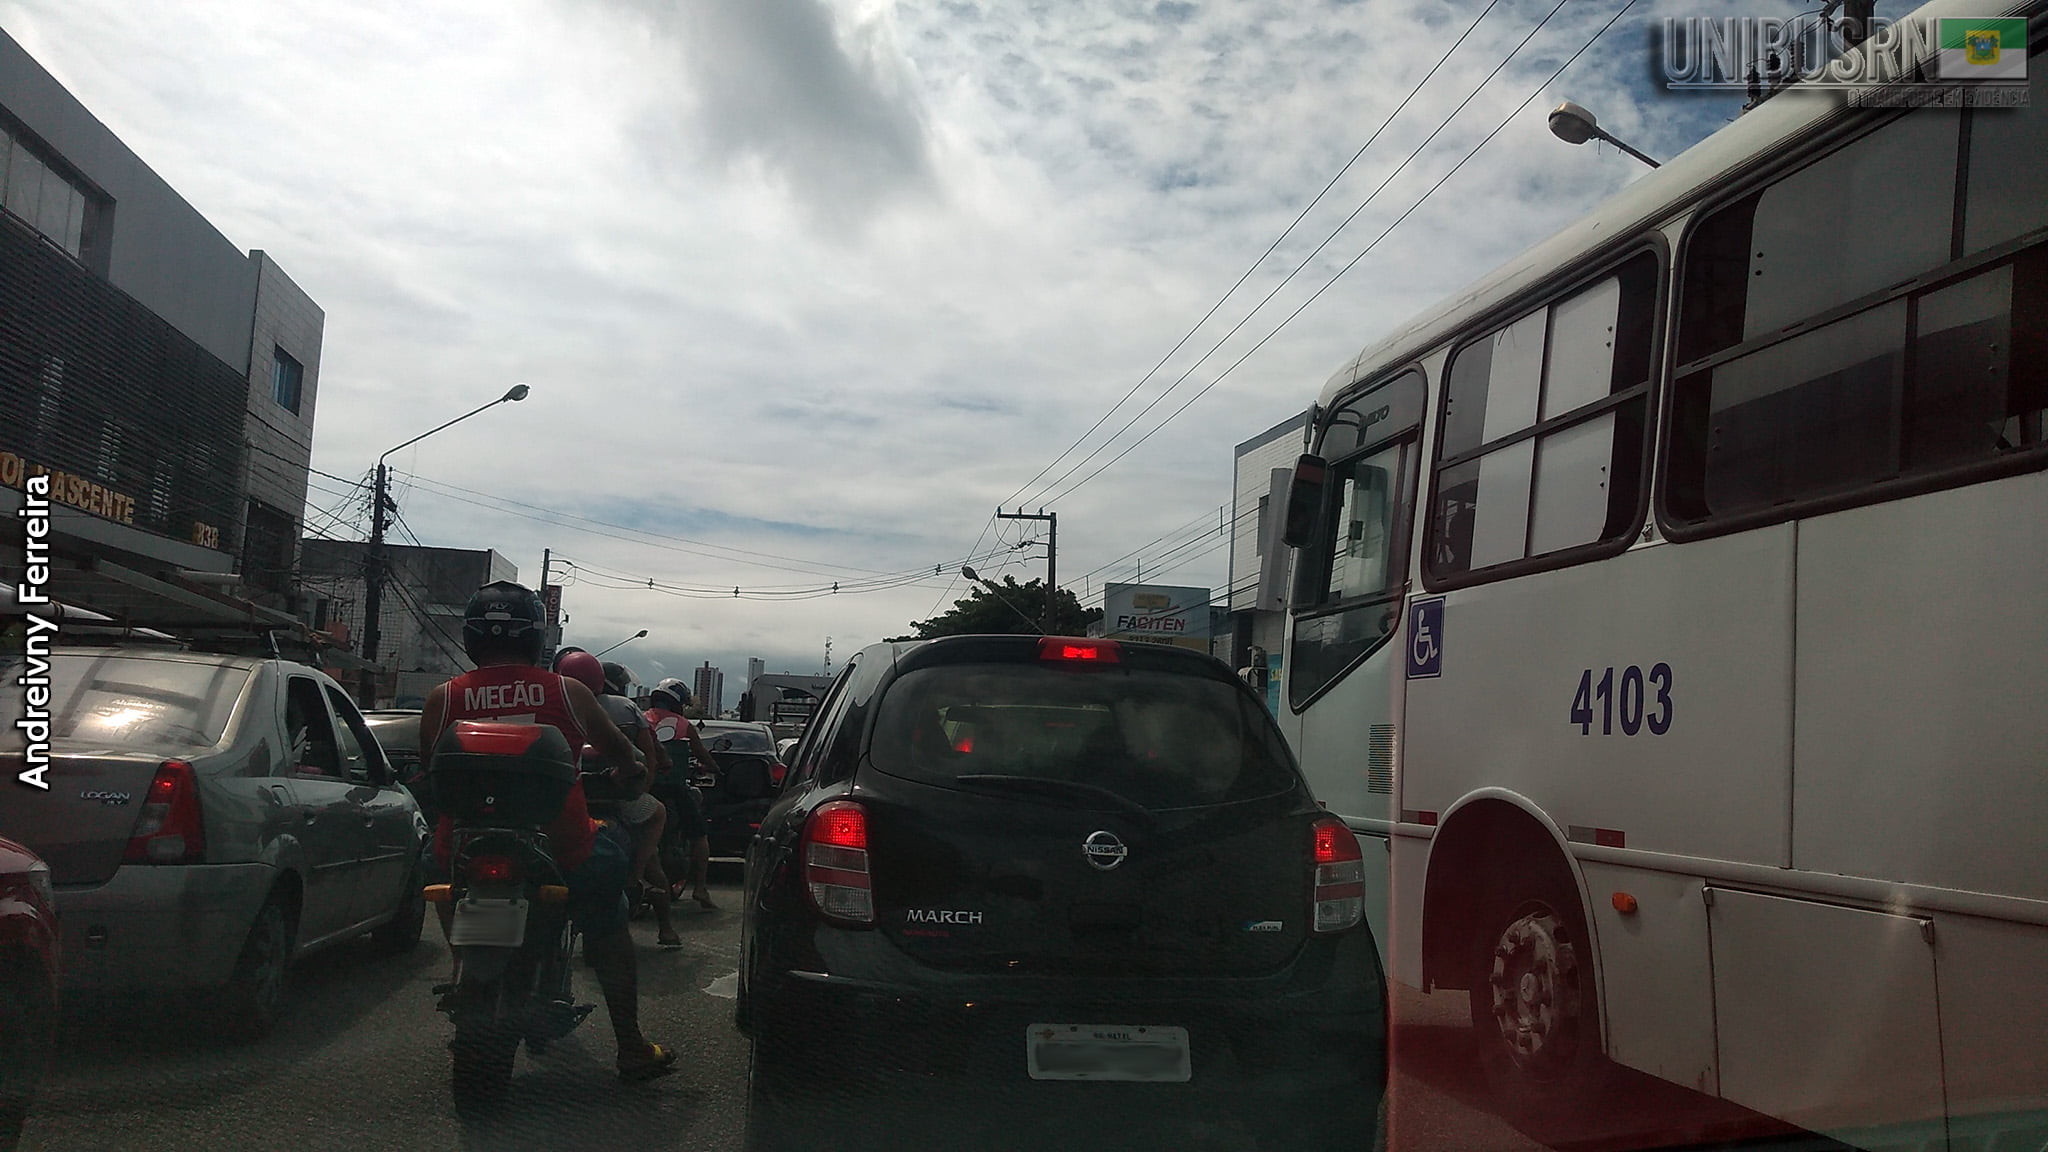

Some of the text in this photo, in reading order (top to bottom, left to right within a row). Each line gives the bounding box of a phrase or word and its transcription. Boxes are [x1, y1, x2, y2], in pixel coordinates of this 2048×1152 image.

[31, 464, 135, 524] ASCENTE
[1117, 616, 1185, 632] FACITEN
[464, 680, 545, 711] MECÃO
[1570, 662, 1673, 736] 4103
[80, 791, 130, 799] LOGAN
[906, 909, 983, 924] MARCH
